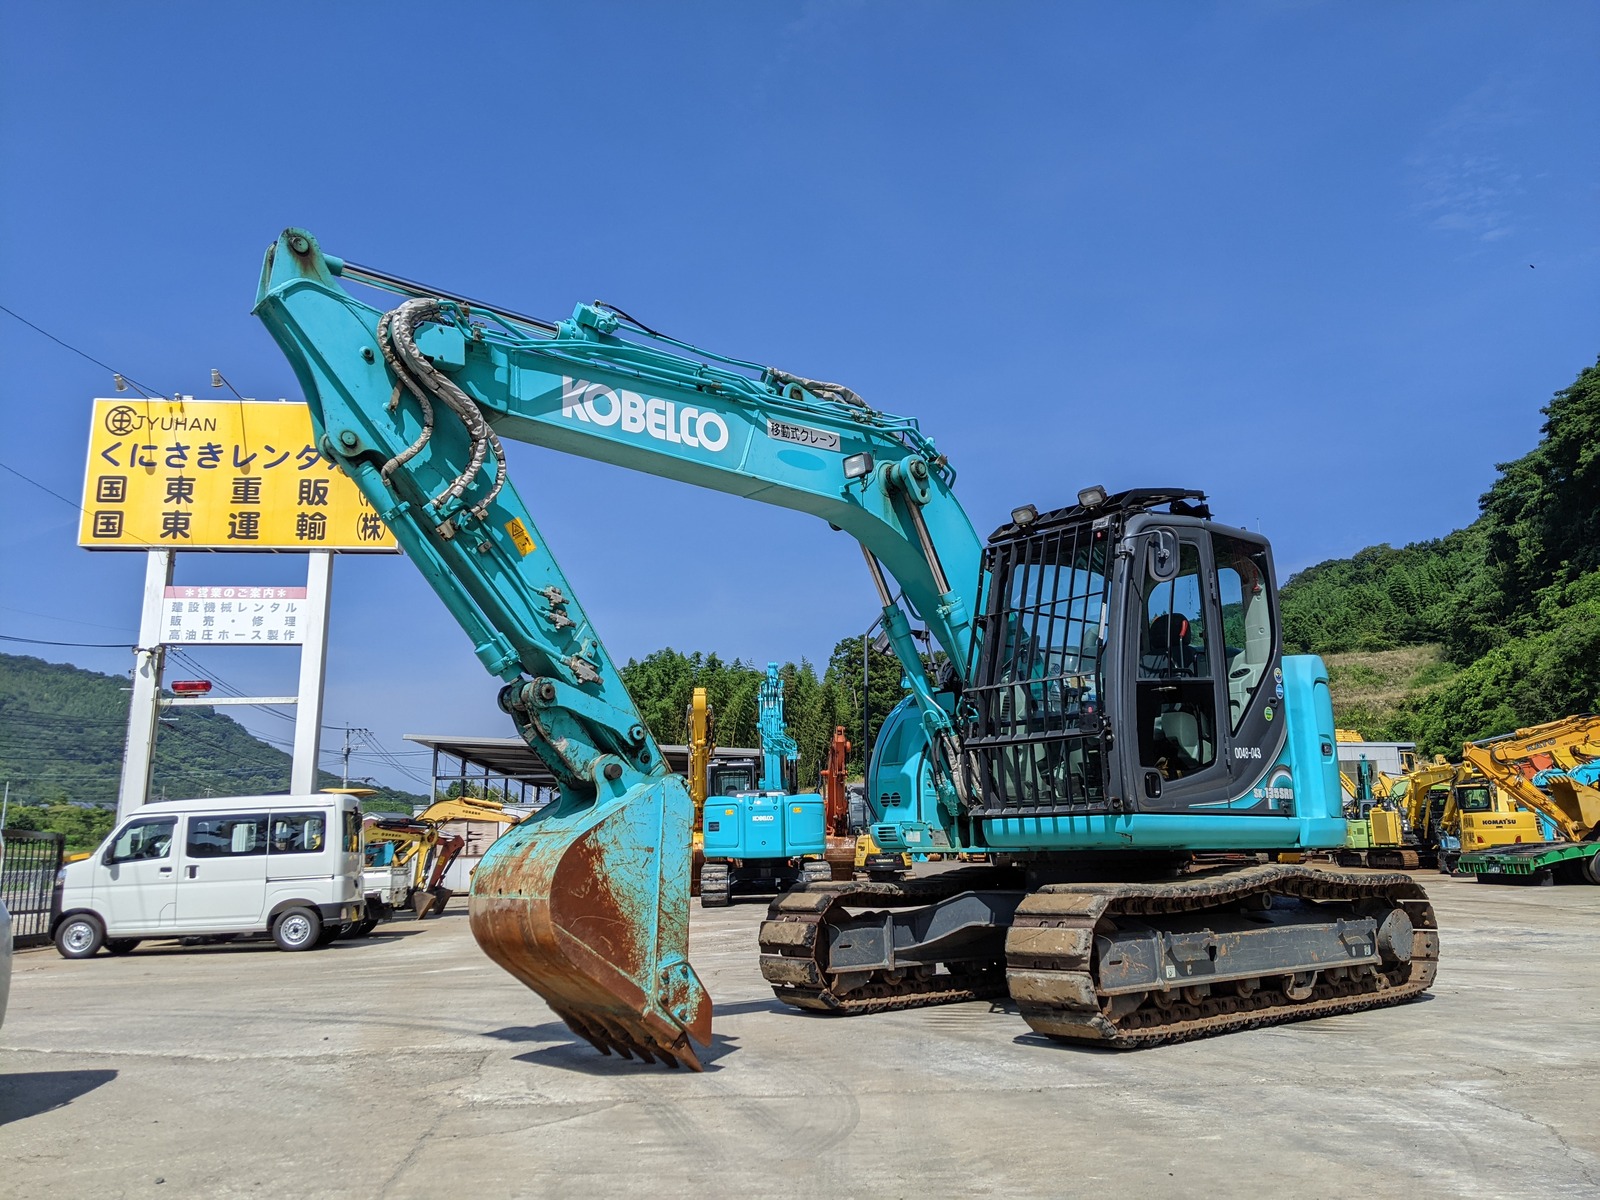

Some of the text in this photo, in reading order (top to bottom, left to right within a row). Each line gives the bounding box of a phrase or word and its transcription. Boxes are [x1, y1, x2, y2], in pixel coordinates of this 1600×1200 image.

[562, 374, 729, 452] KOBELCO
[132, 415, 217, 432] JYUHAN
[771, 422, 838, 448] 移動式クレーン
[171, 601, 297, 613] 建設機械レンタル
[168, 629, 295, 641] 高油圧ホース製作
[1526, 737, 1557, 752] KATO
